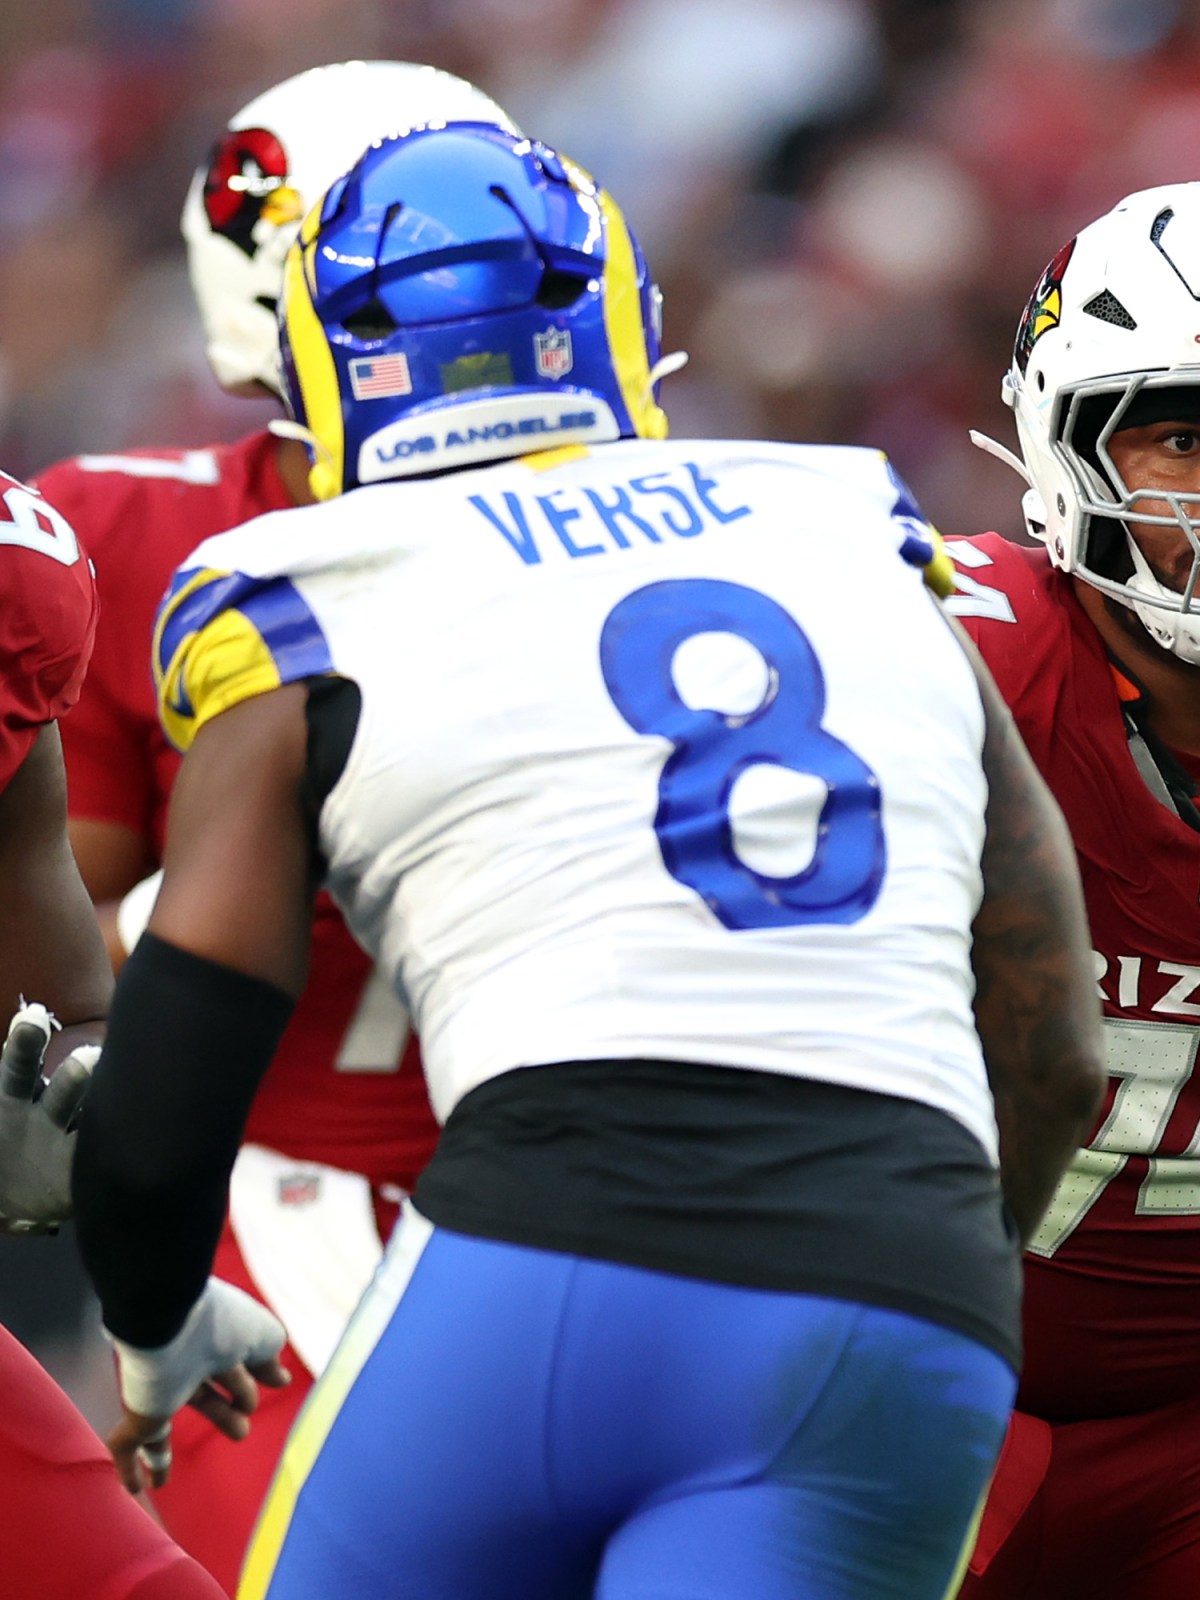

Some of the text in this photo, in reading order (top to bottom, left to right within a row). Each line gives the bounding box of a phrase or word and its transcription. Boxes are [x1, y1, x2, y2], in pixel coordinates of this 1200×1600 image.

[376, 411, 597, 462] LOS ANGELES
[467, 462, 752, 566] VERSE
[599, 577, 887, 931] 8
